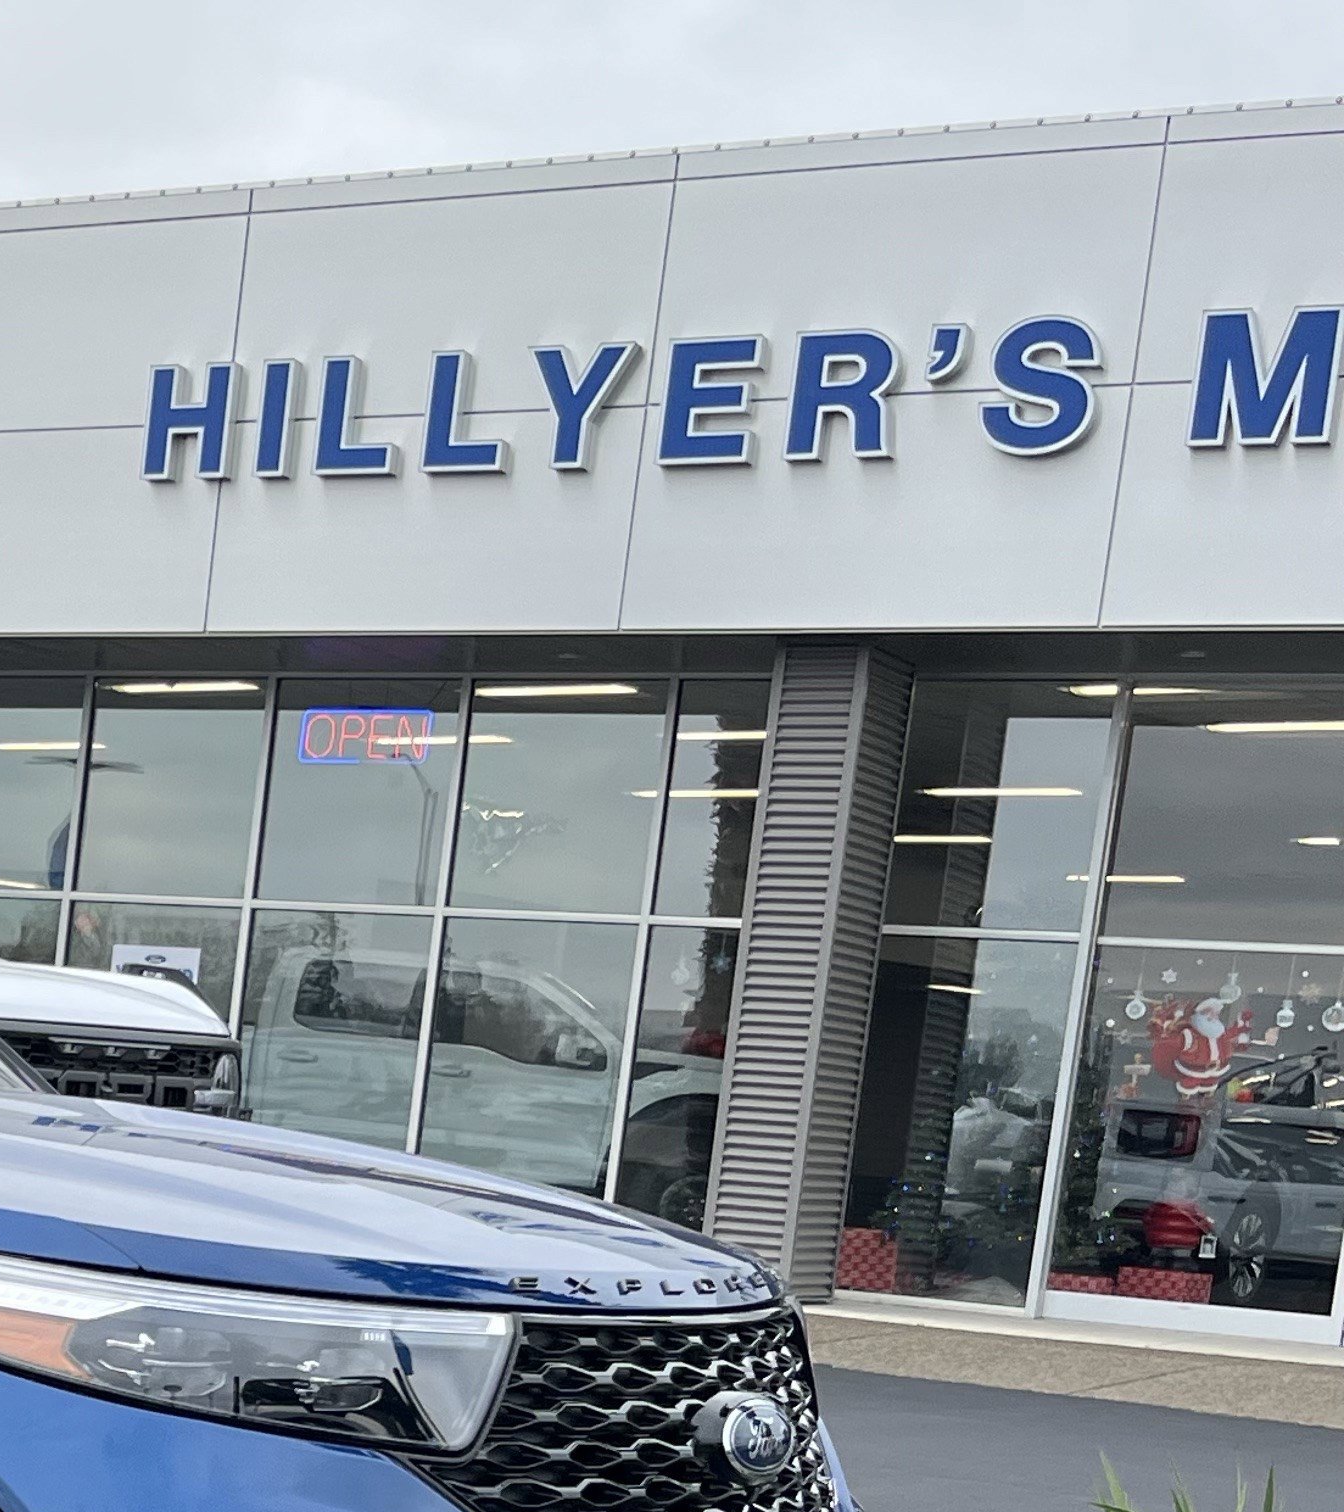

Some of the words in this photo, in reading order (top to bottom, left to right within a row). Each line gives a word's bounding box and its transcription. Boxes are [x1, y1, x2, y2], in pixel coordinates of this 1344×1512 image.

[140, 314, 1105, 482] HILLYER'S
[1186, 304, 1344, 447] M
[304, 713, 429, 760] OPEN
[509, 1271, 774, 1297] EXPLORE
